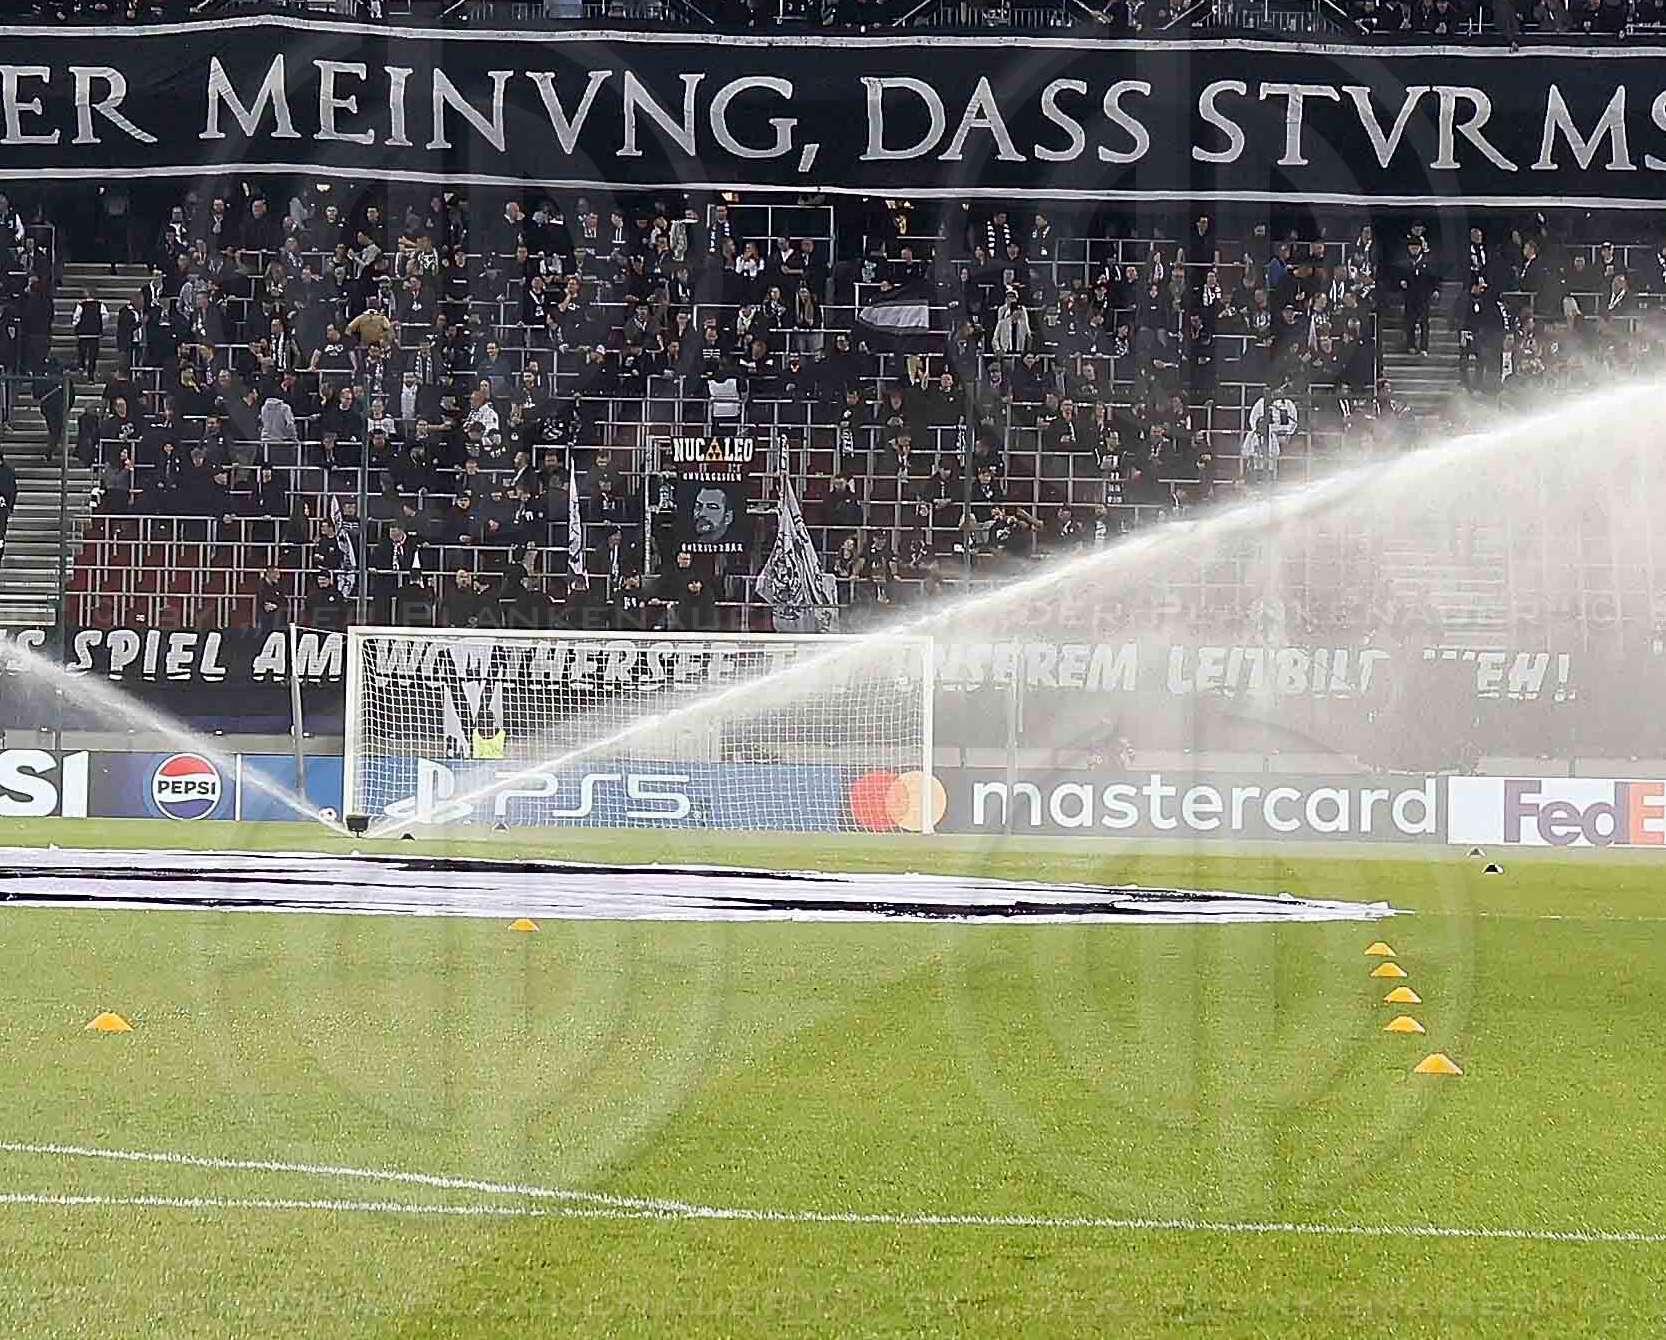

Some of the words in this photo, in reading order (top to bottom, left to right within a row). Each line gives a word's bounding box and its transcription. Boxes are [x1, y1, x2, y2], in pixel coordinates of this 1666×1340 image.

[198, 53, 819, 173] MEINVNG,
[859, 75, 1151, 162] DASS
[66, 629, 227, 681] SPIEL
[252, 631, 342, 682] AM
[1423, 649, 1576, 701] EH!
[157, 780, 217, 797] PEPSI
[493, 771, 691, 819] PS5
[972, 774, 1436, 833] mastercard
